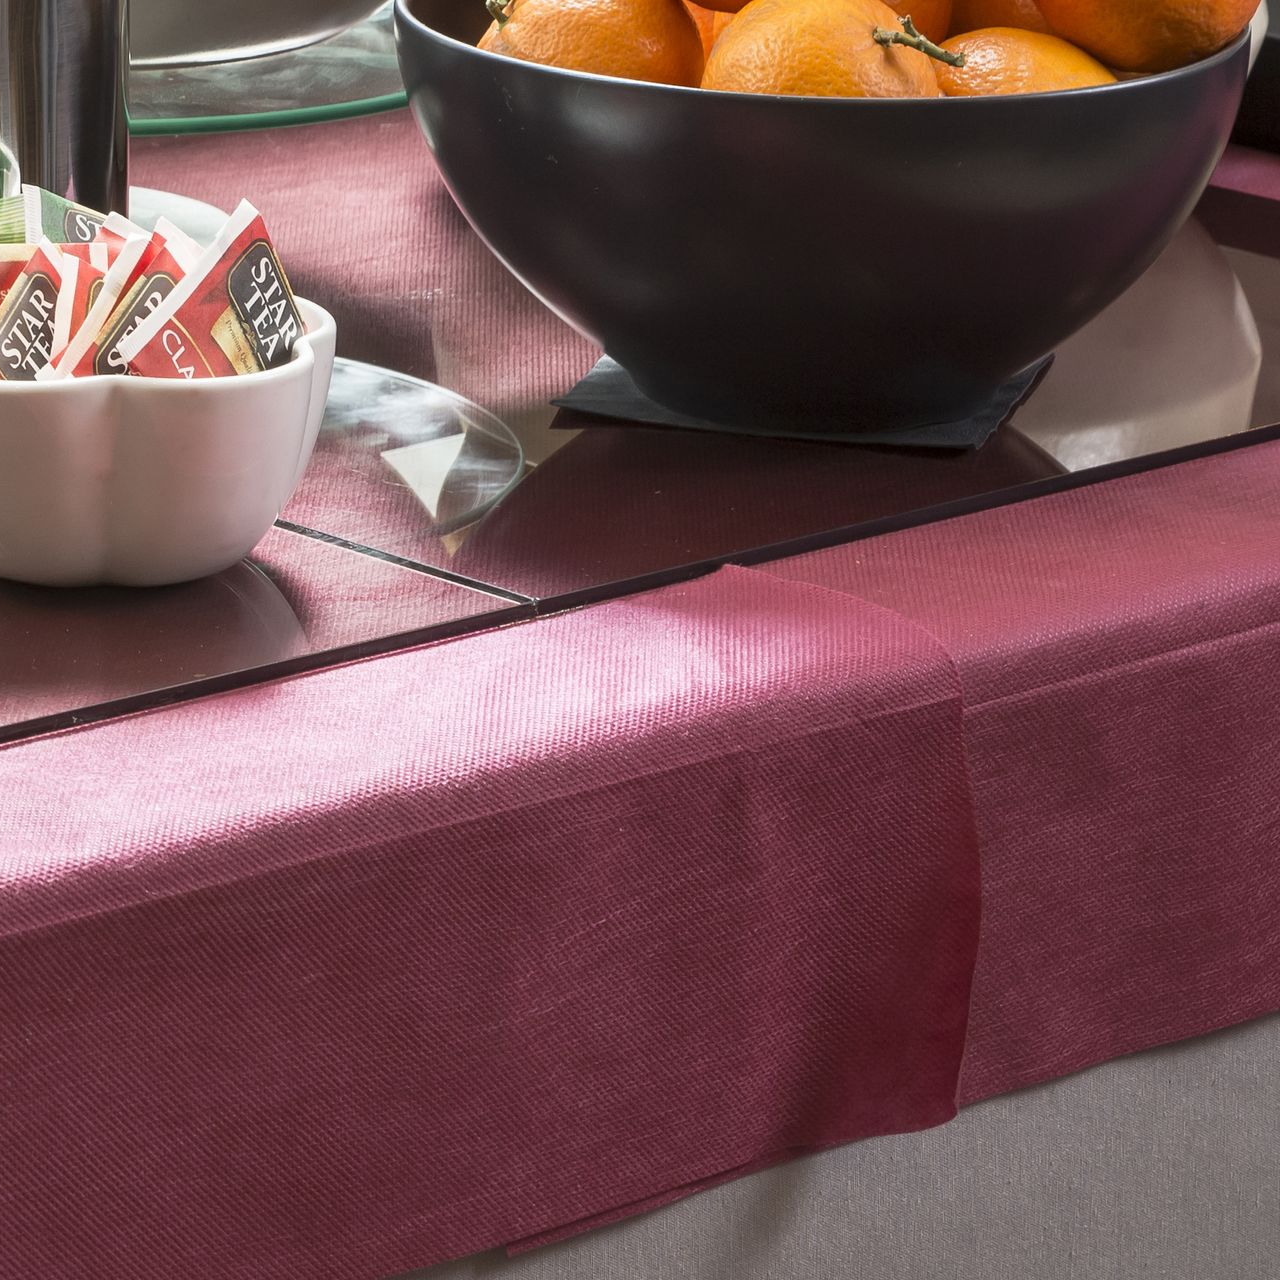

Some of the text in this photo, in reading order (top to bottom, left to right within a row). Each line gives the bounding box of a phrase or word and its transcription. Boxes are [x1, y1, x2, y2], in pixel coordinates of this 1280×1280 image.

[1, 289, 54, 369] STAR
[243, 281, 280, 361] TEA
[250, 256, 298, 350] STAR
